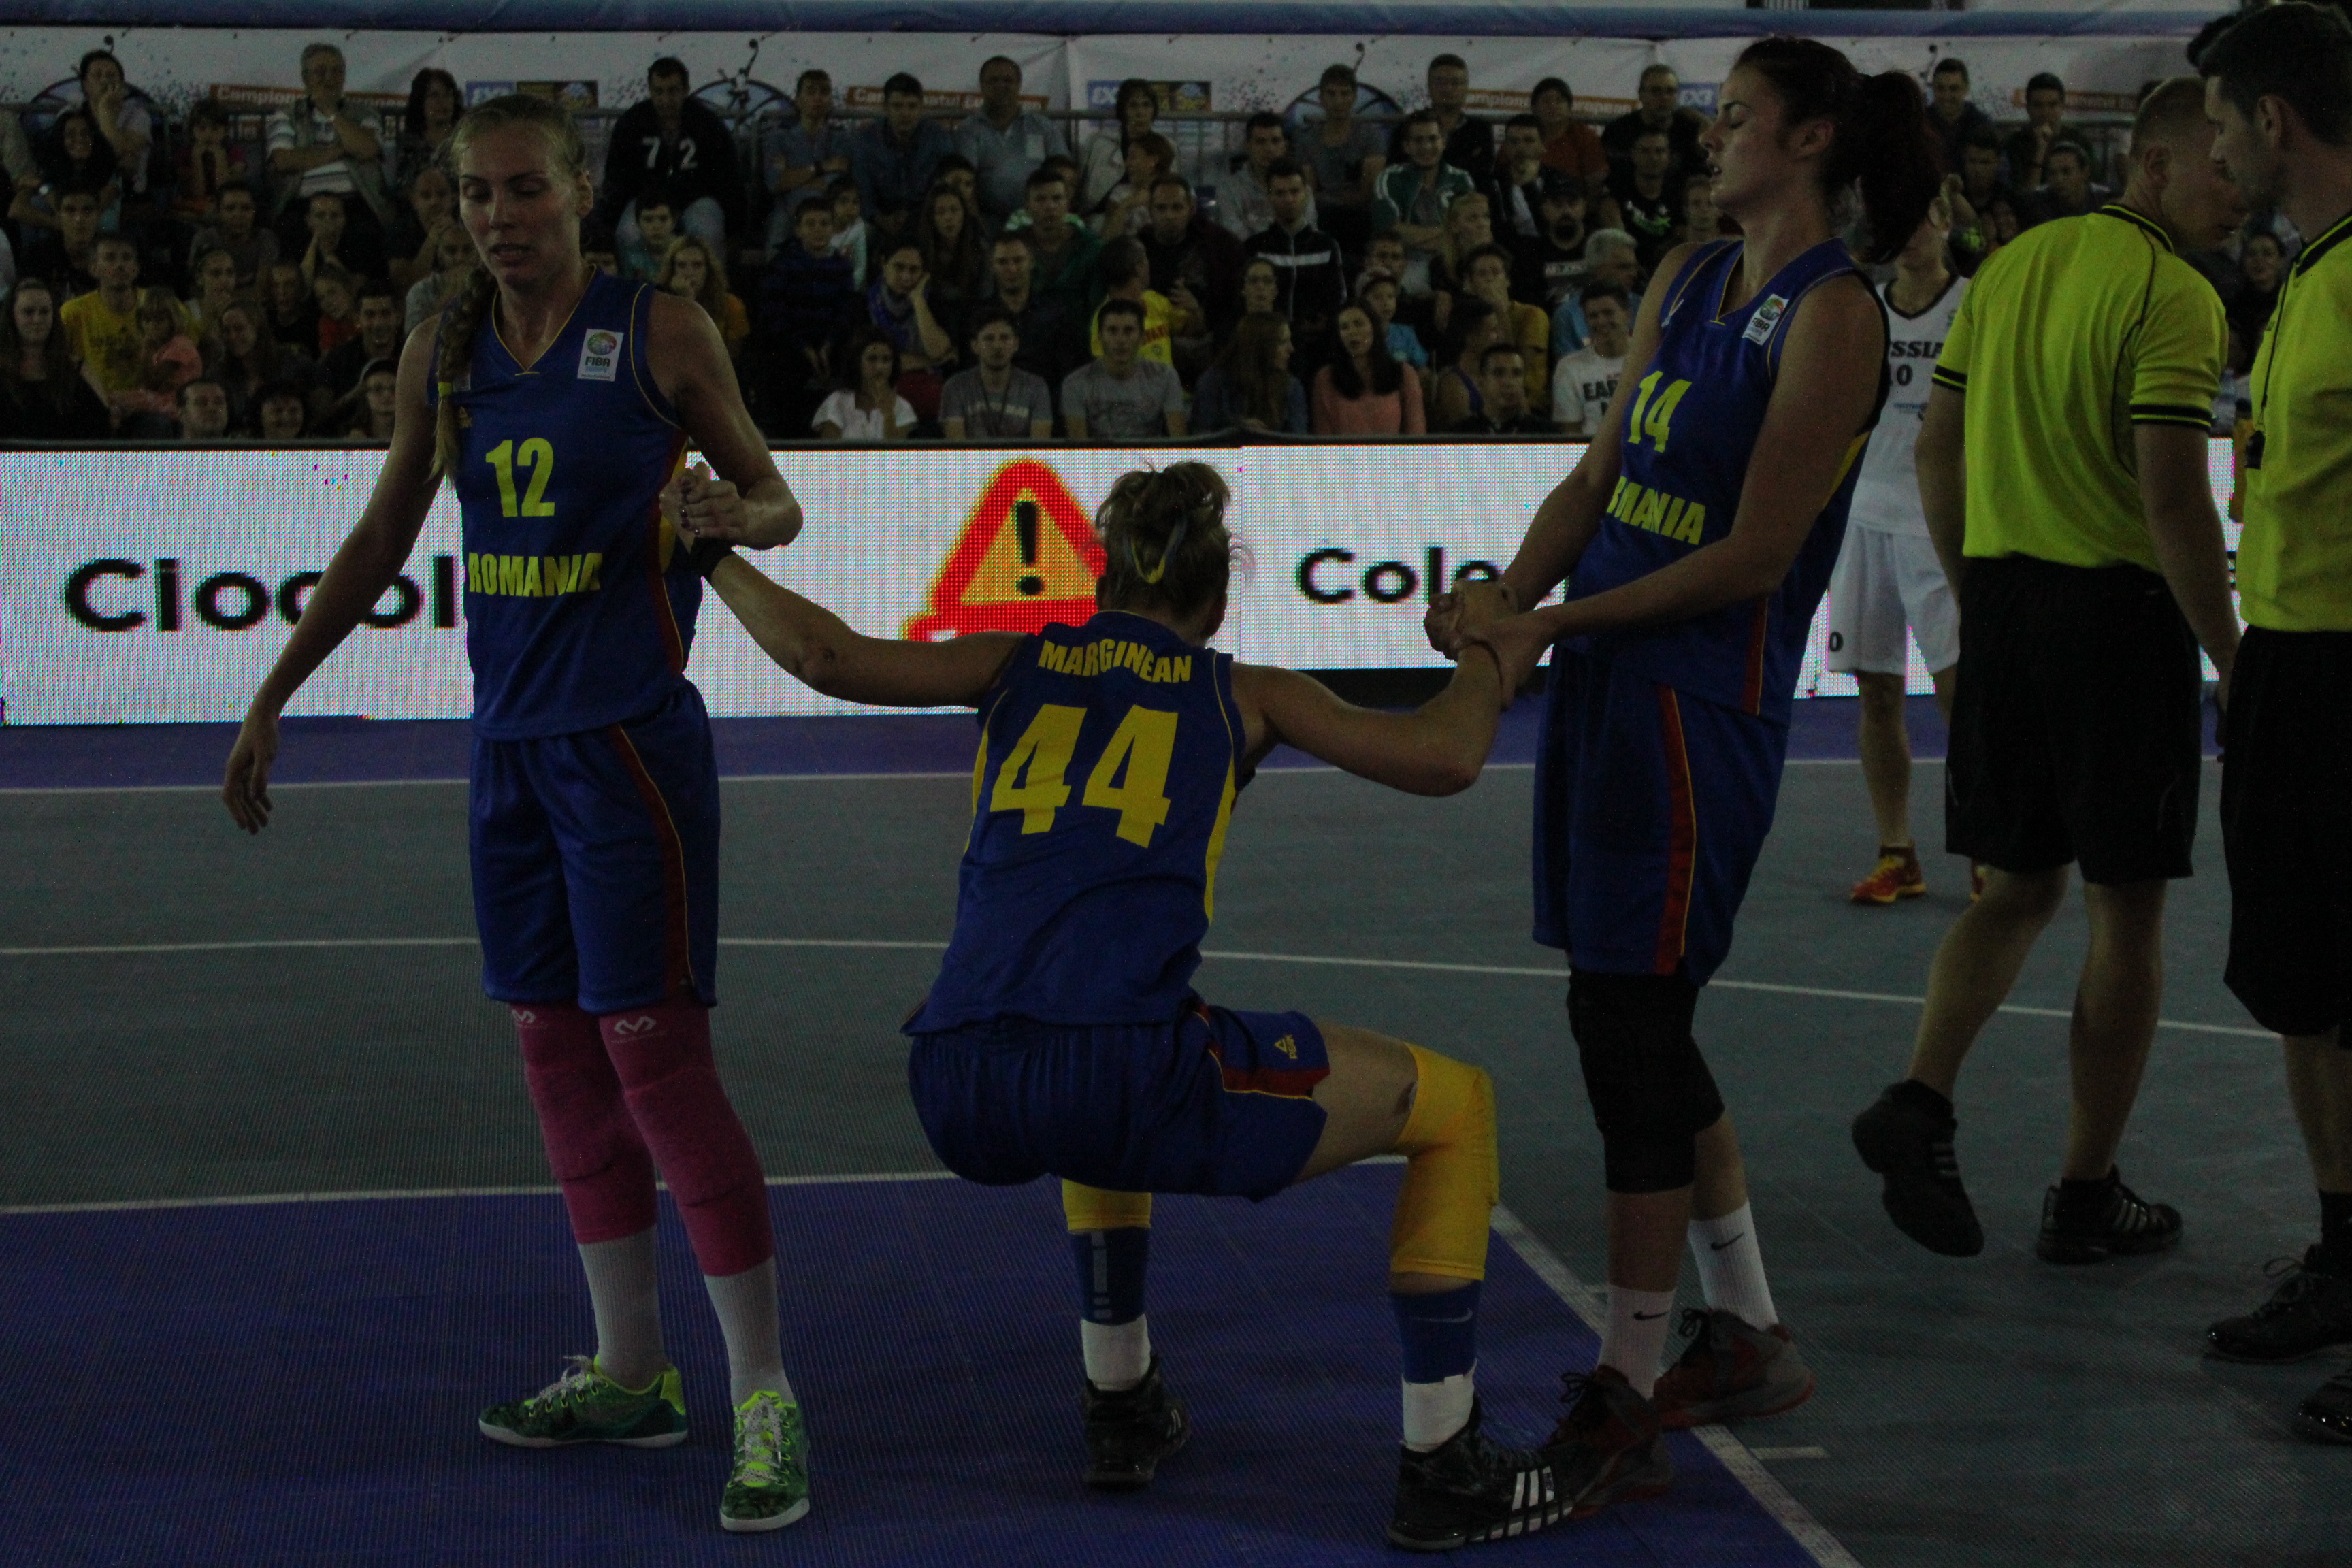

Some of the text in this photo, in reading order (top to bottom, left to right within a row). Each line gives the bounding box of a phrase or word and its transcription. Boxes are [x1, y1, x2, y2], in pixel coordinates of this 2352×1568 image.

[1752, 318, 1770, 332] FIBA
[585, 356, 611, 368] FIBA
[1627, 370, 1693, 453] 14
[486, 437, 555, 517] 12
[468, 553, 604, 598] ROMANIA
[1037, 638, 1192, 683] MARGINEAN
[990, 703, 1178, 848] 44
